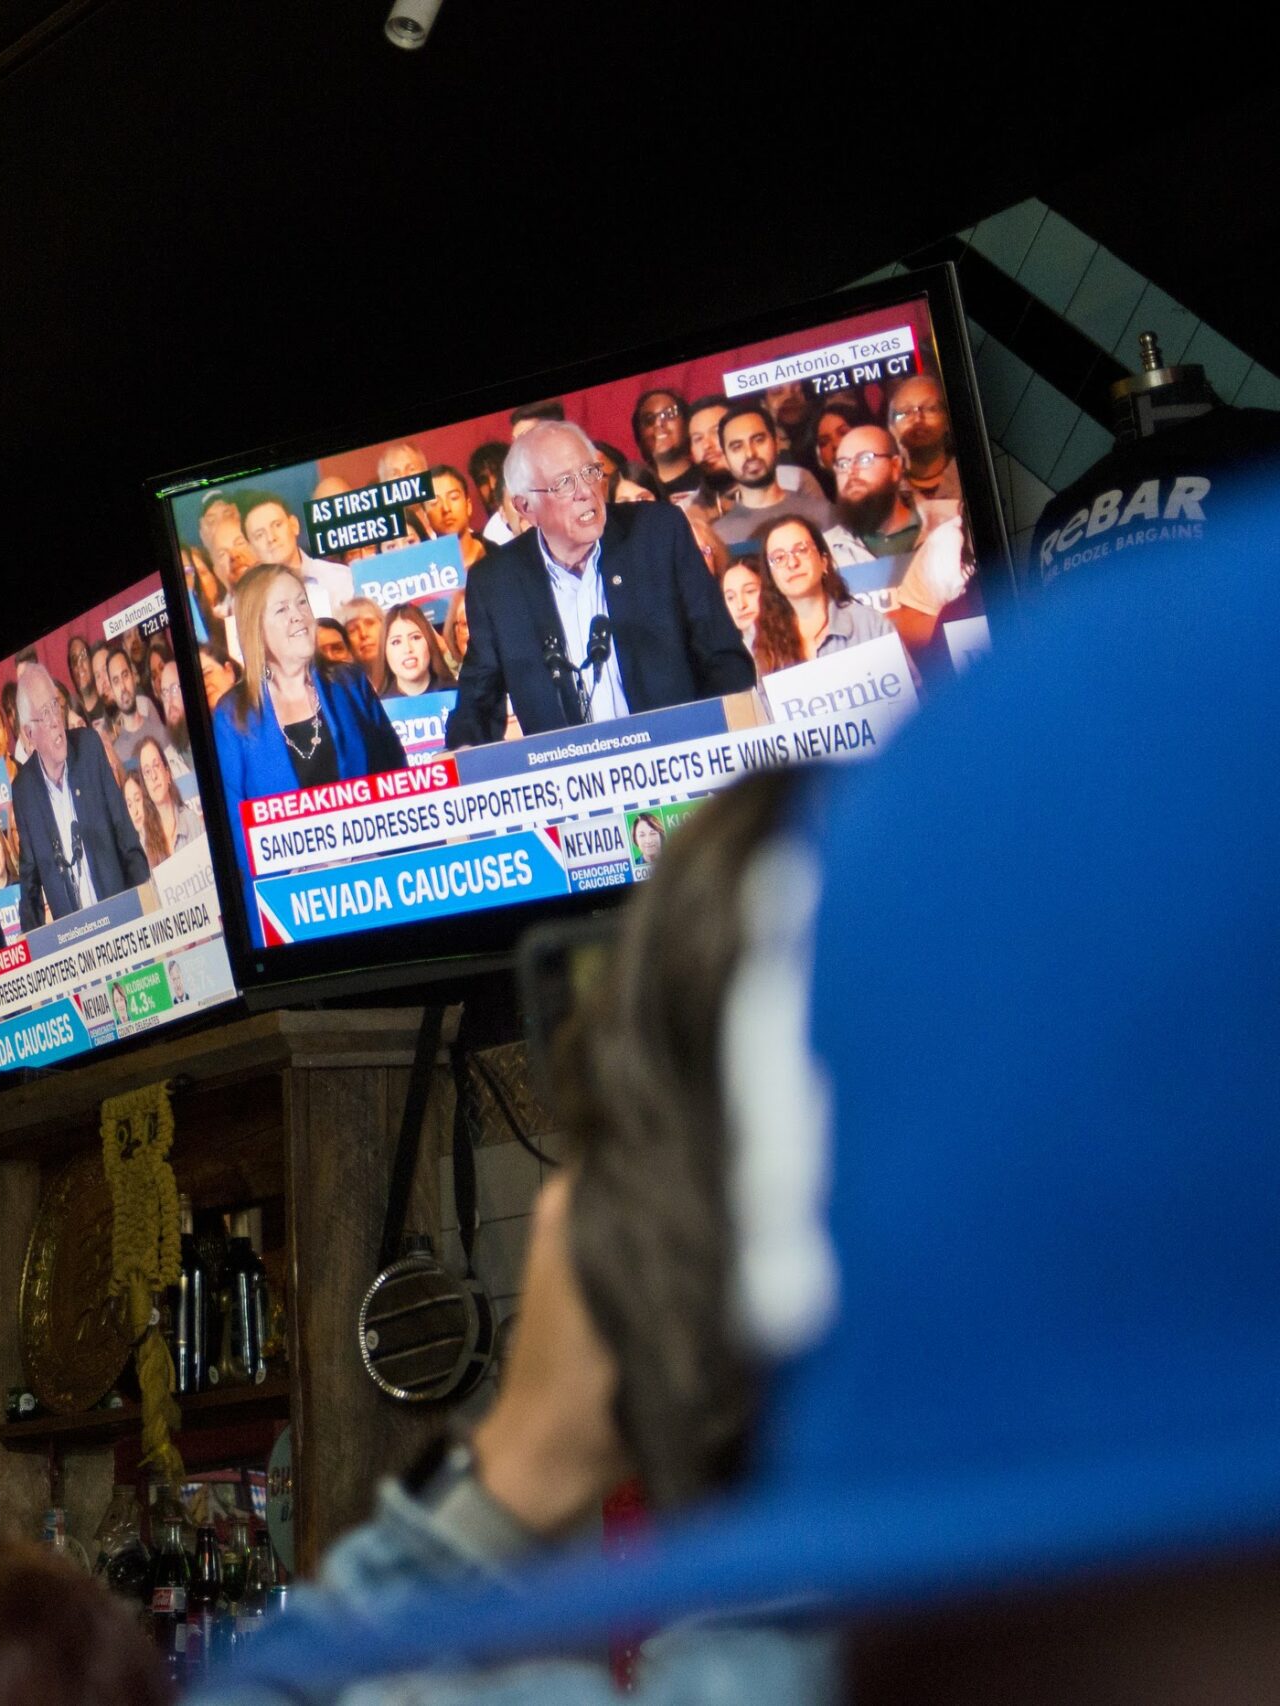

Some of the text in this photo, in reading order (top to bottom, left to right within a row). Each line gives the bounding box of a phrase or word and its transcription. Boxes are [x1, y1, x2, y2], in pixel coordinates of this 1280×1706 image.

[737, 337, 901, 389] San Antonio, Texas
[812, 356, 909, 393] 7:21 PM CT
[312, 478, 426, 523] AS FIRST LADY.
[327, 517, 388, 549] CHEERS
[361, 562, 459, 608] Bernie
[109, 619, 123, 633] San
[142, 618, 159, 636] 7:21
[782, 671, 902, 722] Bernie
[527, 731, 651, 766] BernieSanders.com
[252, 764, 448, 823] BREAKING NEWS
[260, 718, 876, 861] SANDERS ADDRESSES SUPPORTERS; CNN PROJECTS HE WINS NEVADA
[564, 825, 625, 860] NEVADA
[290, 850, 533, 926] NEVADA CAUCUSES
[570, 860, 630, 881] DEMOCRATIC
[578, 873, 626, 890] CAUCUSES
[27, 962, 77, 998] SUPPORTERS;
[77, 955, 98, 978] CNN
[97, 935, 138, 969] PROJECTS
[138, 928, 150, 949] HE
[151, 919, 174, 945] WINS
[175, 903, 211, 935] NEVADA
[83, 993, 111, 1021] NEVADA
[130, 992, 156, 1015] 4.3%
[14, 1013, 74, 1055] CAUCUSES
